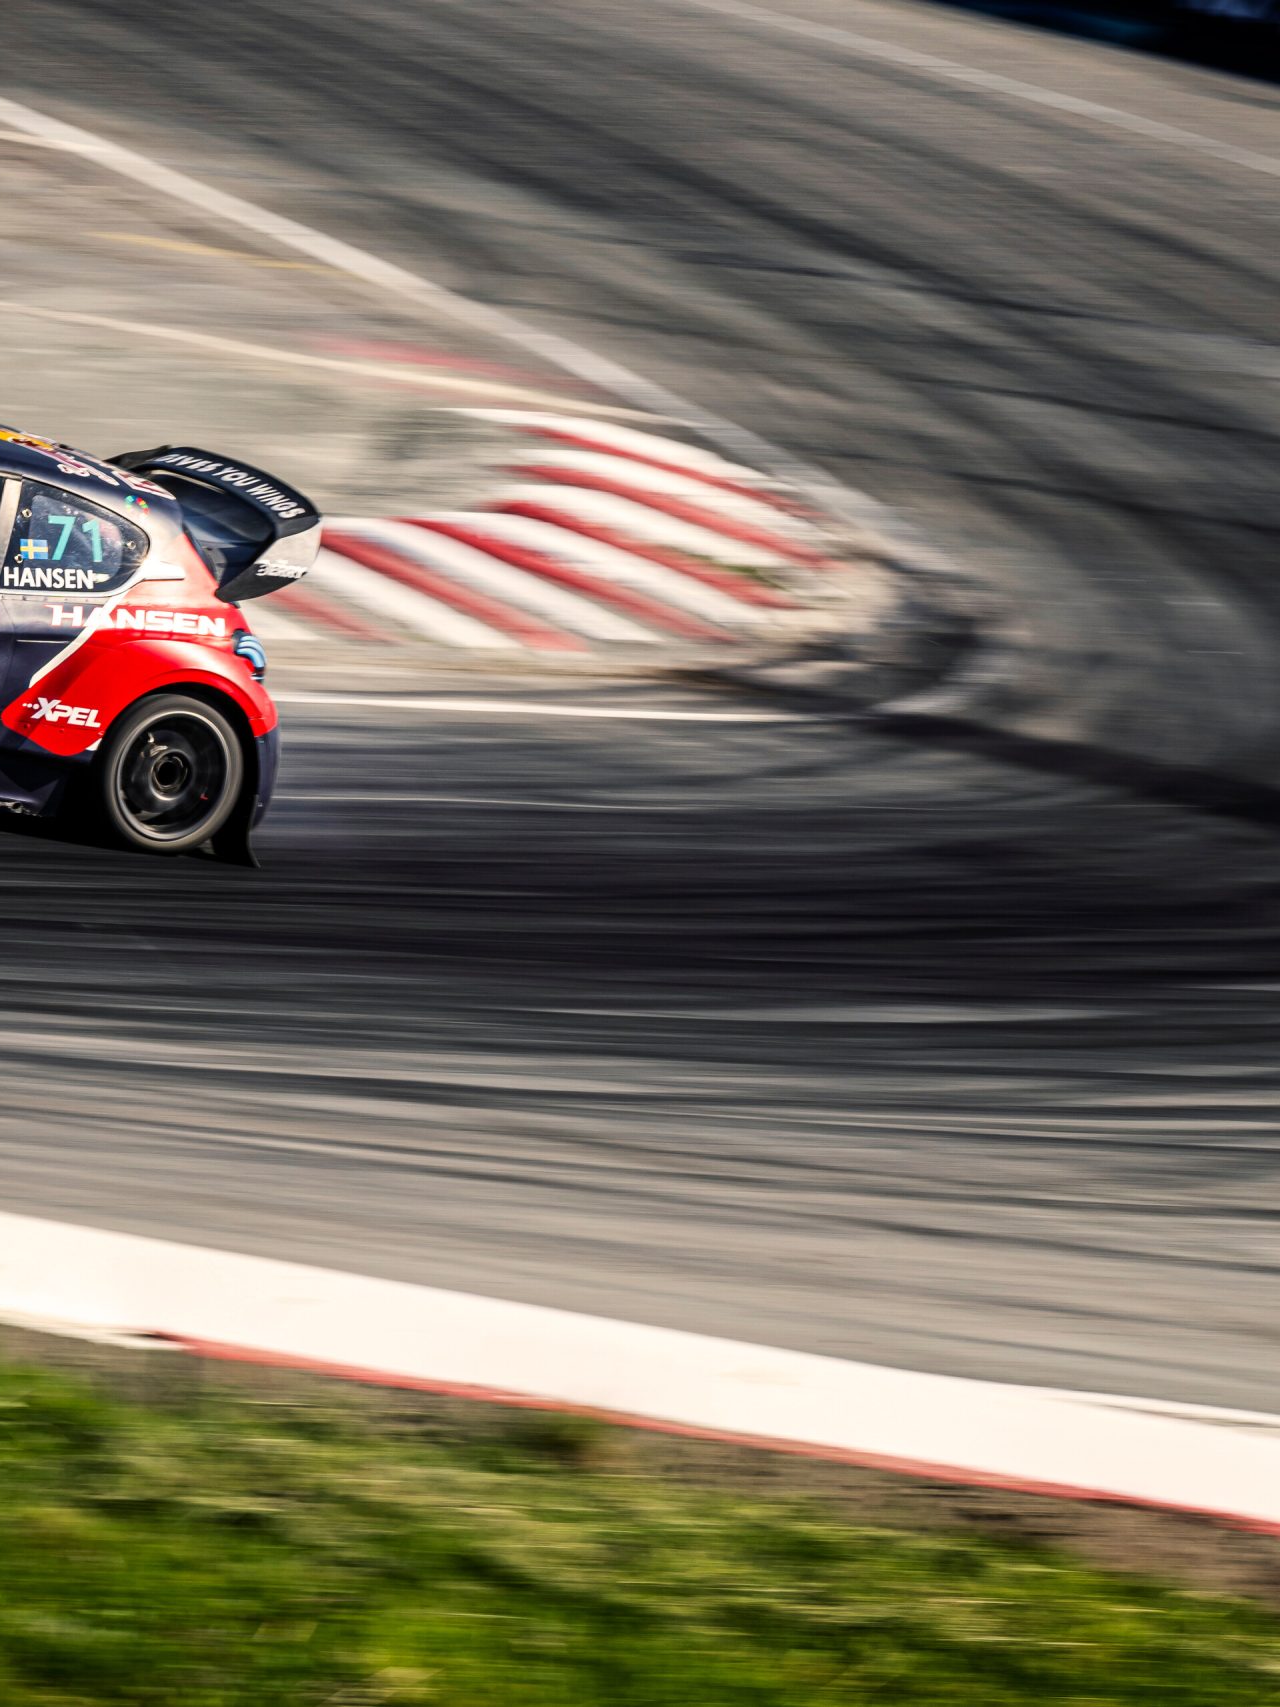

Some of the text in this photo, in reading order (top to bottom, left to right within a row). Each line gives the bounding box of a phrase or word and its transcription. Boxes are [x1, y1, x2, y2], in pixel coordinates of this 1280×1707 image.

[213, 467, 260, 487] YOU
[246, 483, 306, 519] WINGS
[48, 515, 103, 562] 71
[3, 566, 95, 590] HANSEN
[45, 605, 226, 637] HANSEN
[28, 697, 101, 728] XPEL
